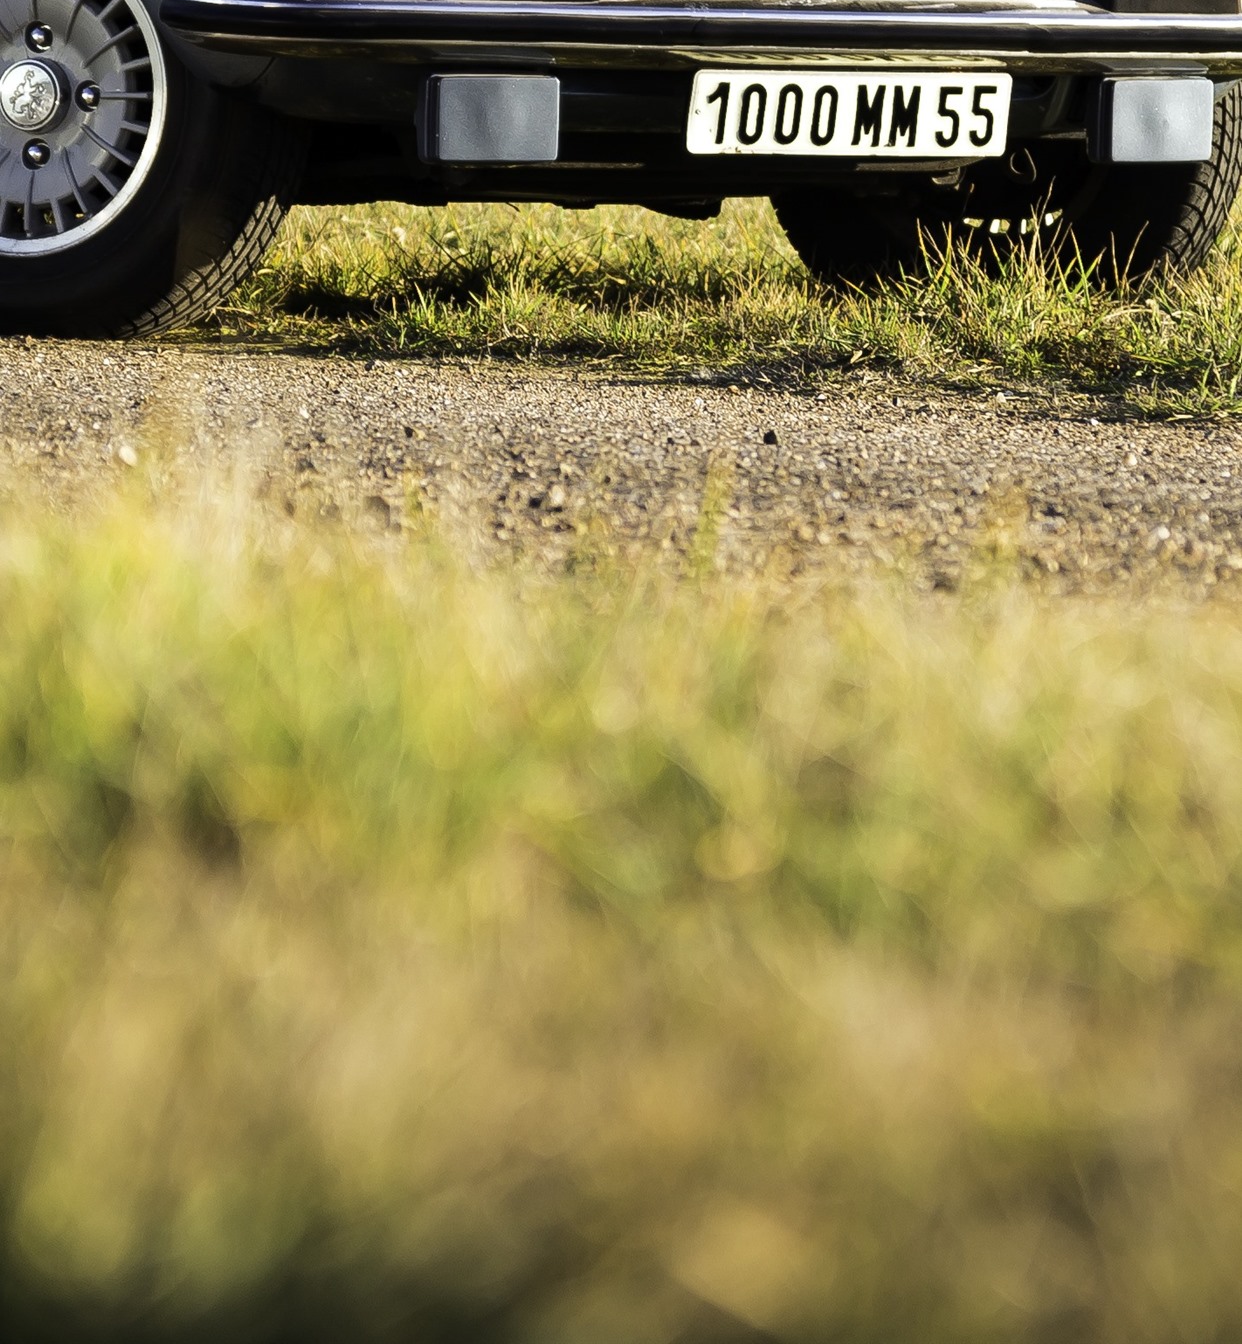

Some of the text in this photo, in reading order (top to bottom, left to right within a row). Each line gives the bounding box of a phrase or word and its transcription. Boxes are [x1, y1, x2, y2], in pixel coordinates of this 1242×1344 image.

[706, 82, 998, 148] 1000 MM 55
